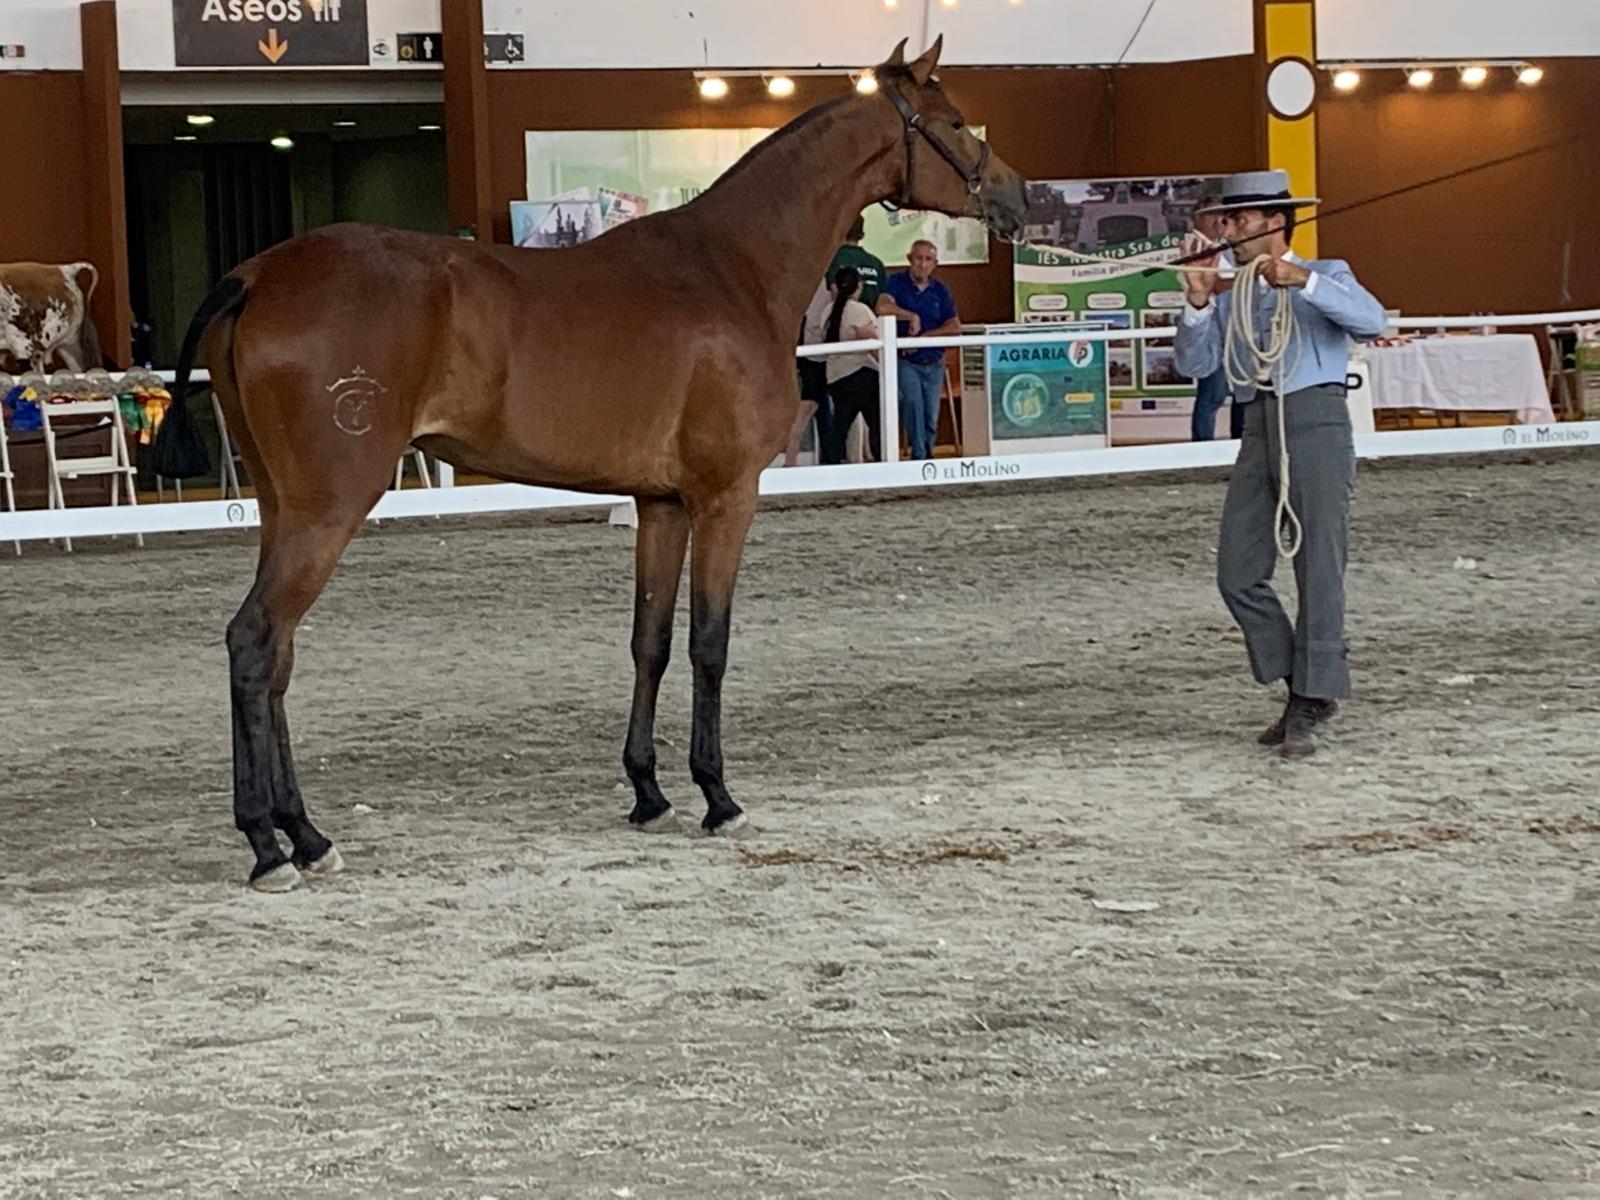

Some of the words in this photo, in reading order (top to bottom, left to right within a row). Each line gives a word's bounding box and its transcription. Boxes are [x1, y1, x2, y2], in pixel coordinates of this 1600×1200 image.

[201, 0, 302, 22] Aseos
[1038, 252, 1060, 265] IES
[1128, 242, 1157, 255] Sra.
[1161, 235, 1180, 248] de
[998, 347, 1067, 362] AGRARIA
[943, 467, 956, 479] EL
